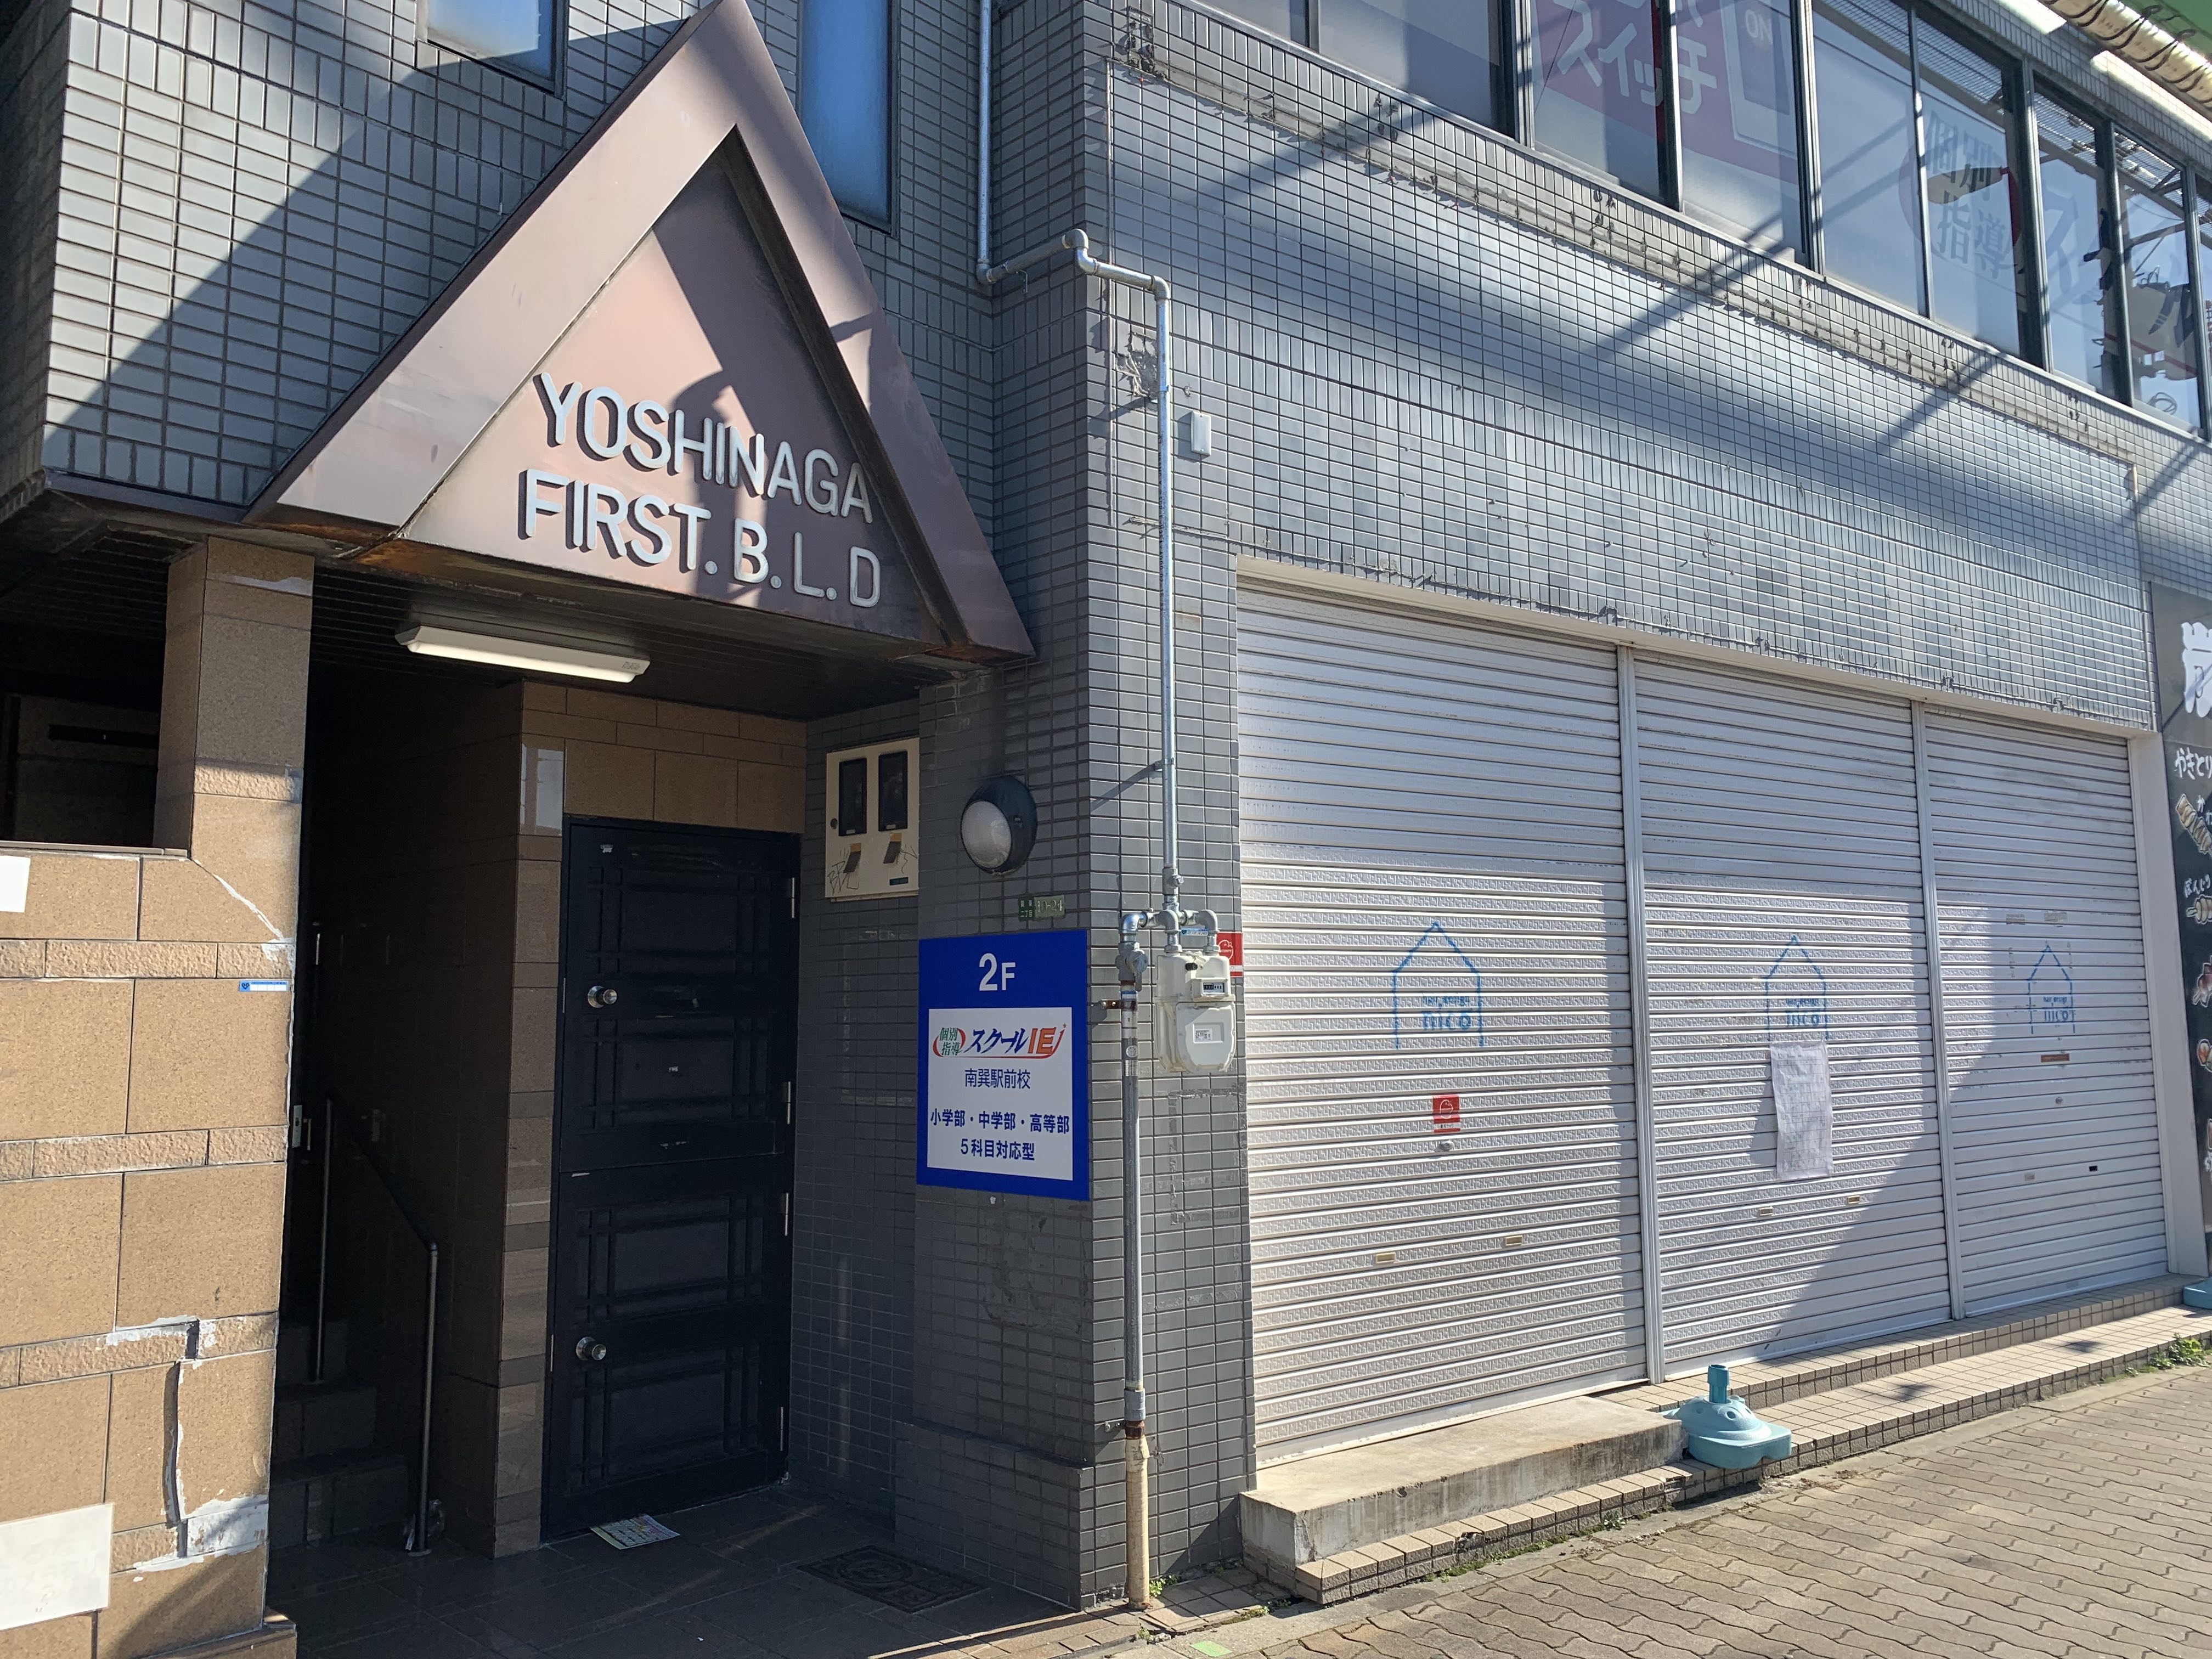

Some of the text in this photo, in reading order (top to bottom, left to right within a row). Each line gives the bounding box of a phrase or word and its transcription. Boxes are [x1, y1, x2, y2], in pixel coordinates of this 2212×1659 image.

[1937, 190, 2019, 279] 指導
[535, 372, 873, 523] YOSHINAGA
[979, 952, 1016, 991] 2F
[940, 1027, 958, 1041] 個別
[941, 1042, 960, 1056] 指導
[964, 1068, 1031, 1090] 南巽駅前校
